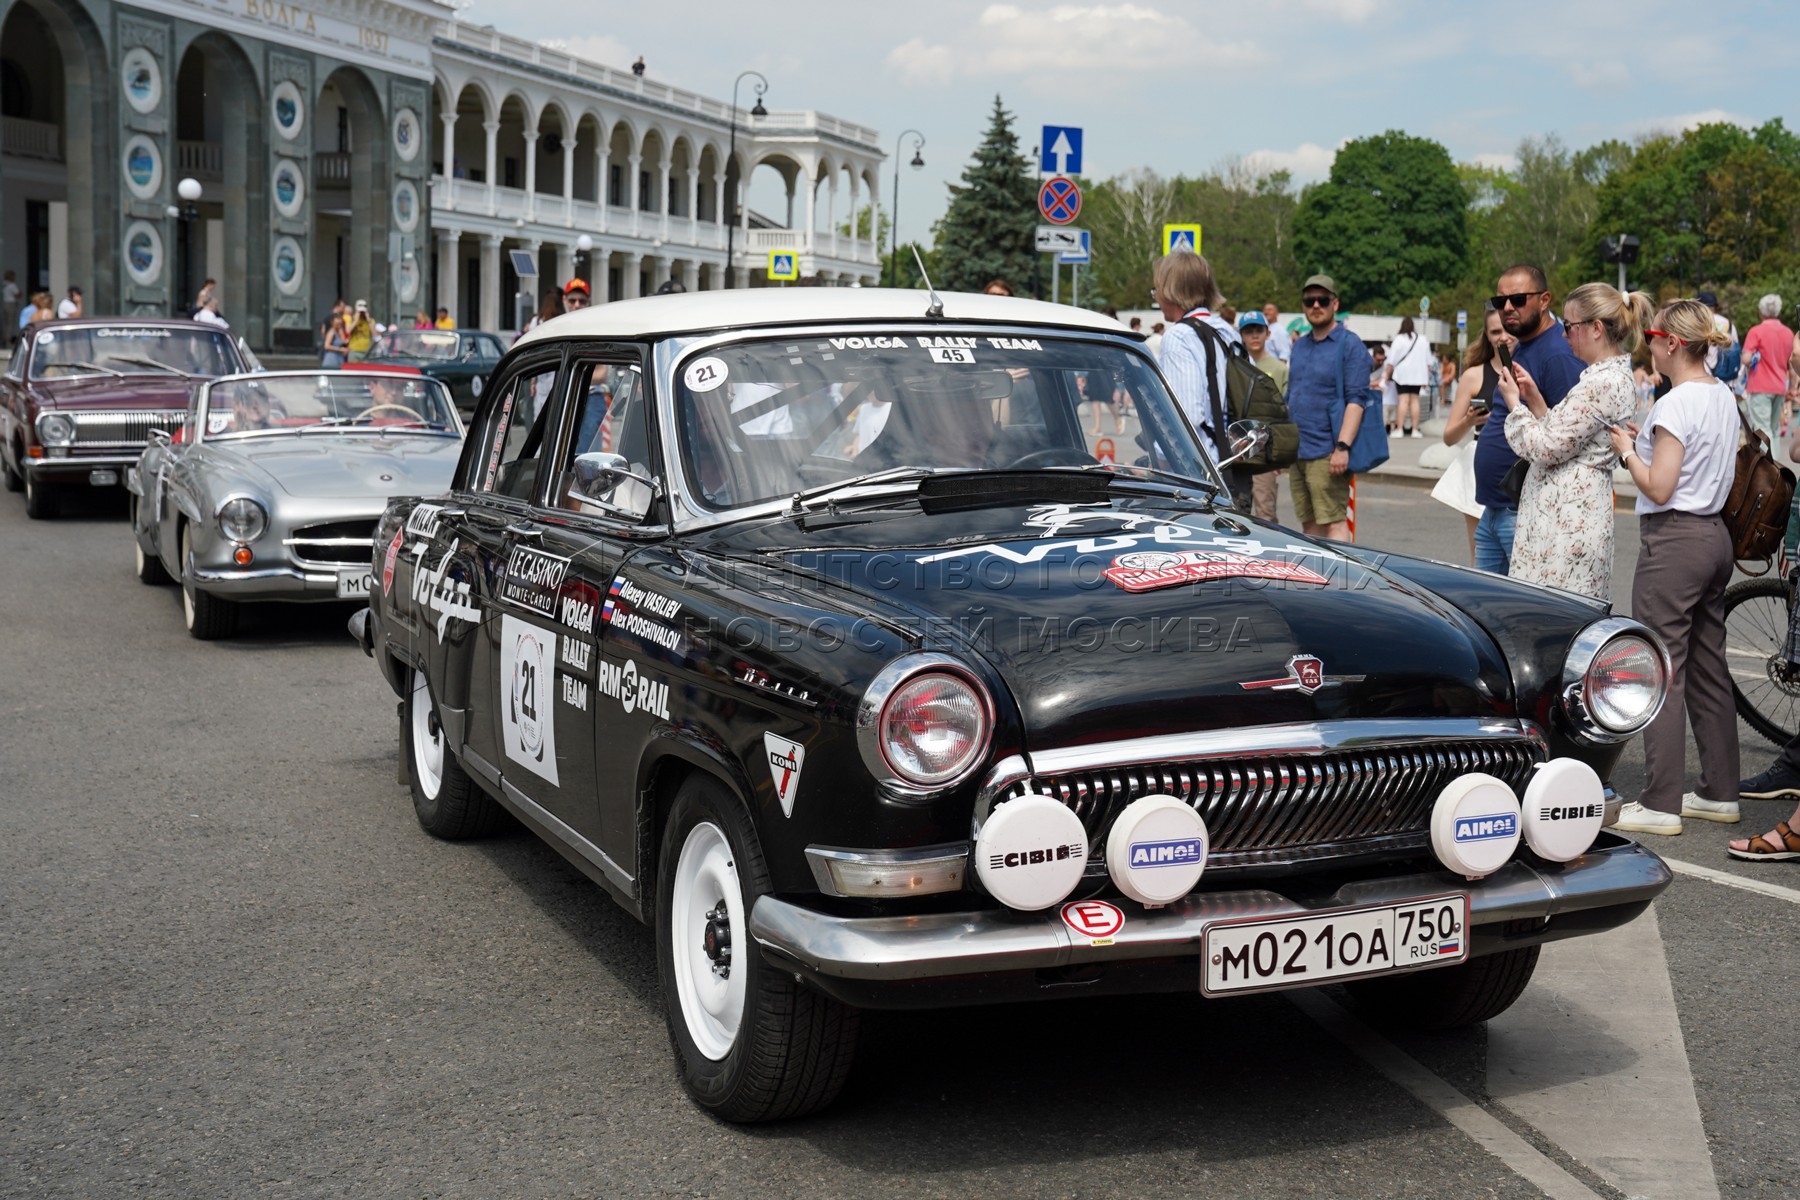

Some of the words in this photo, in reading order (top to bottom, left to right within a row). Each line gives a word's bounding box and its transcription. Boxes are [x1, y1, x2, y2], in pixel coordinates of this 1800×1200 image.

[245, 0, 317, 31] ВОЛГА
[829, 336, 908, 351] VOLGA
[916, 336, 977, 350] RALLY
[987, 337, 1043, 351] TEAM
[940, 349, 965, 363] 45
[696, 365, 717, 383] 21
[409, 507, 438, 535] MILAN
[1194, 552, 1227, 563] 45
[506, 583, 551, 611] MONTE-CARLO
[618, 581, 646, 608] Alexey
[643, 591, 682, 619] VASILIEV
[561, 596, 595, 634] VOLGA
[610, 608, 628, 630] Alex
[625, 613, 681, 651] PODSHIVALOV
[562, 635, 591, 671] RALLY
[522, 659, 537, 722] 21
[562, 673, 587, 712] TEAM
[598, 660, 622, 700] RM
[637, 675, 670, 721] RAIL
[772, 754, 796, 772] KONI
[1075, 905, 1111, 928] E
[1398, 905, 1455, 946] 750
[1410, 943, 1438, 959] RUS
